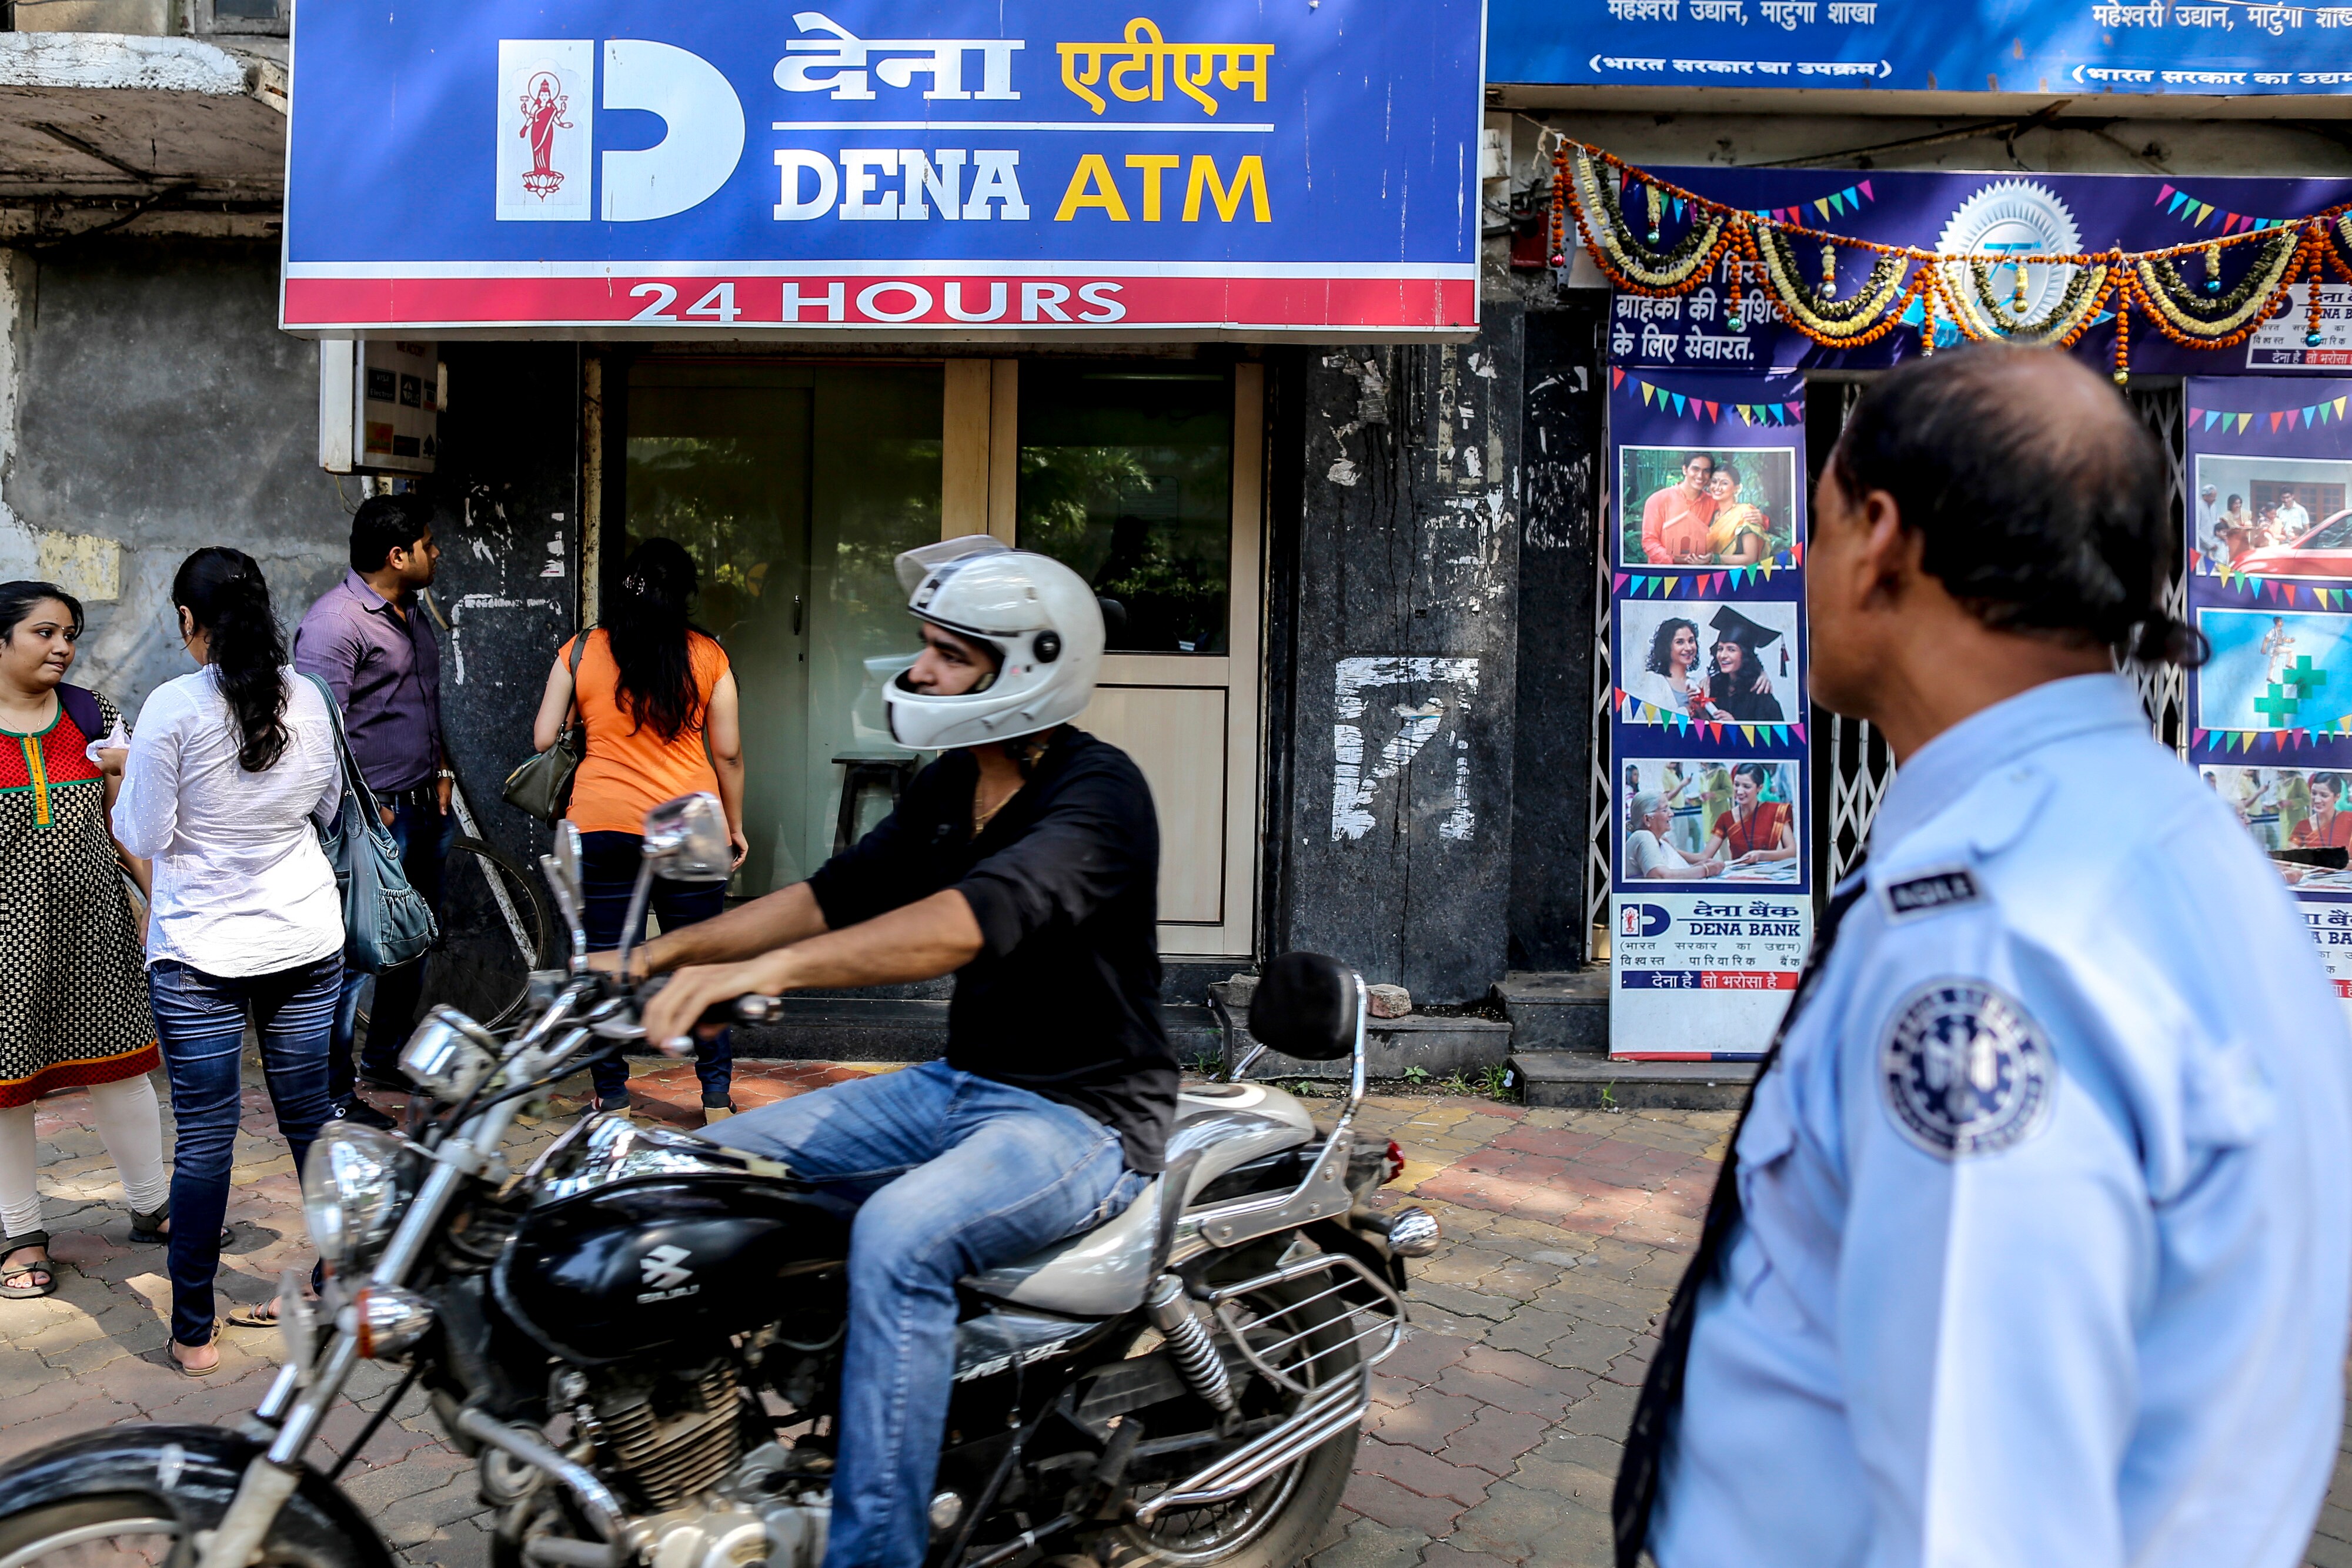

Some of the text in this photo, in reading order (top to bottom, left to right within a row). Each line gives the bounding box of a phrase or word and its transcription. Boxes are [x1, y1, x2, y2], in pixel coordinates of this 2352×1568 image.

[1689, 1, 1749, 26] उद्यान,
[1760, 0, 1818, 31] माटुगा
[1827, 2, 1878, 25] शाखा
[2092, 0, 2165, 28] महेश्वरी
[2176, 6, 2234, 32] उद्यान,
[2247, 1, 2305, 36] माटुंगा
[772, 11, 1275, 116] देना एटीएम
[1672, 59, 1755, 75] सरकार
[2161, 71, 2247, 85] सरकार
[2254, 72, 2293, 85] का
[773, 148, 1272, 223] DENA ATM
[629, 281, 1127, 323] 24 HOURS
[1689, 287, 1717, 321] की
[2304, 308, 2341, 319] DNA
[1613, 322, 1755, 363] के लिए सेवारत.
[1693, 901, 1799, 918] देना बैंक
[1689, 922, 1801, 937] DENA BANK
[1676, 942, 1718, 951] सरकार
[1736, 942, 1751, 951] का
[1652, 971, 1779, 989] देना है तो भरोसा है
